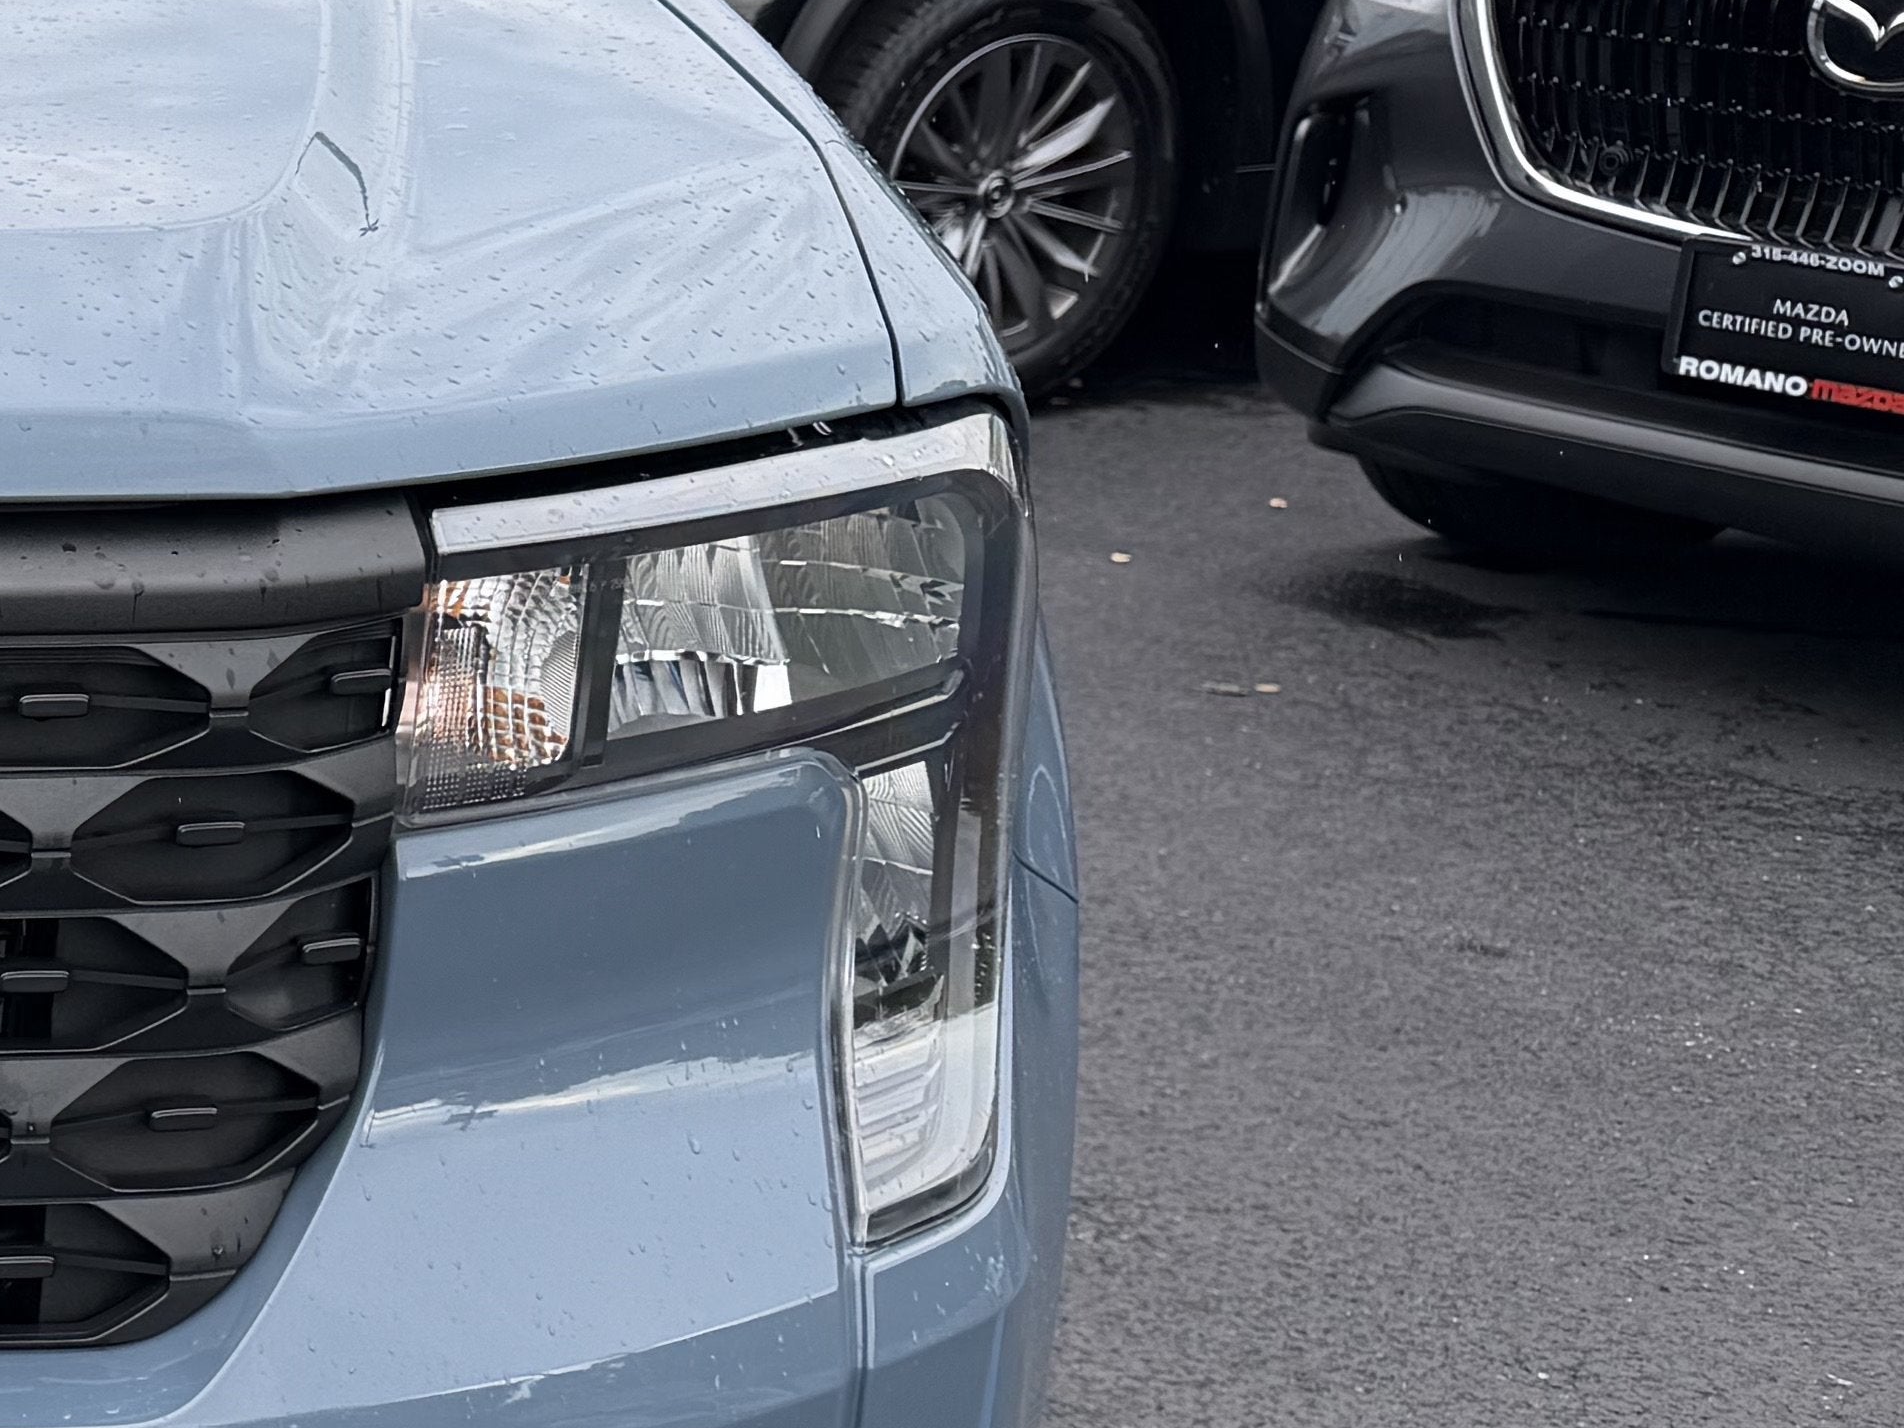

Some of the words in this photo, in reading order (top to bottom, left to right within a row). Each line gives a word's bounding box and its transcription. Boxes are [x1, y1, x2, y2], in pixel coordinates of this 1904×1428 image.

[1698, 309, 1793, 340] CERTIFIED
[1773, 298, 1850, 327] MAZDA
[1678, 355, 1808, 397] ROMANO
